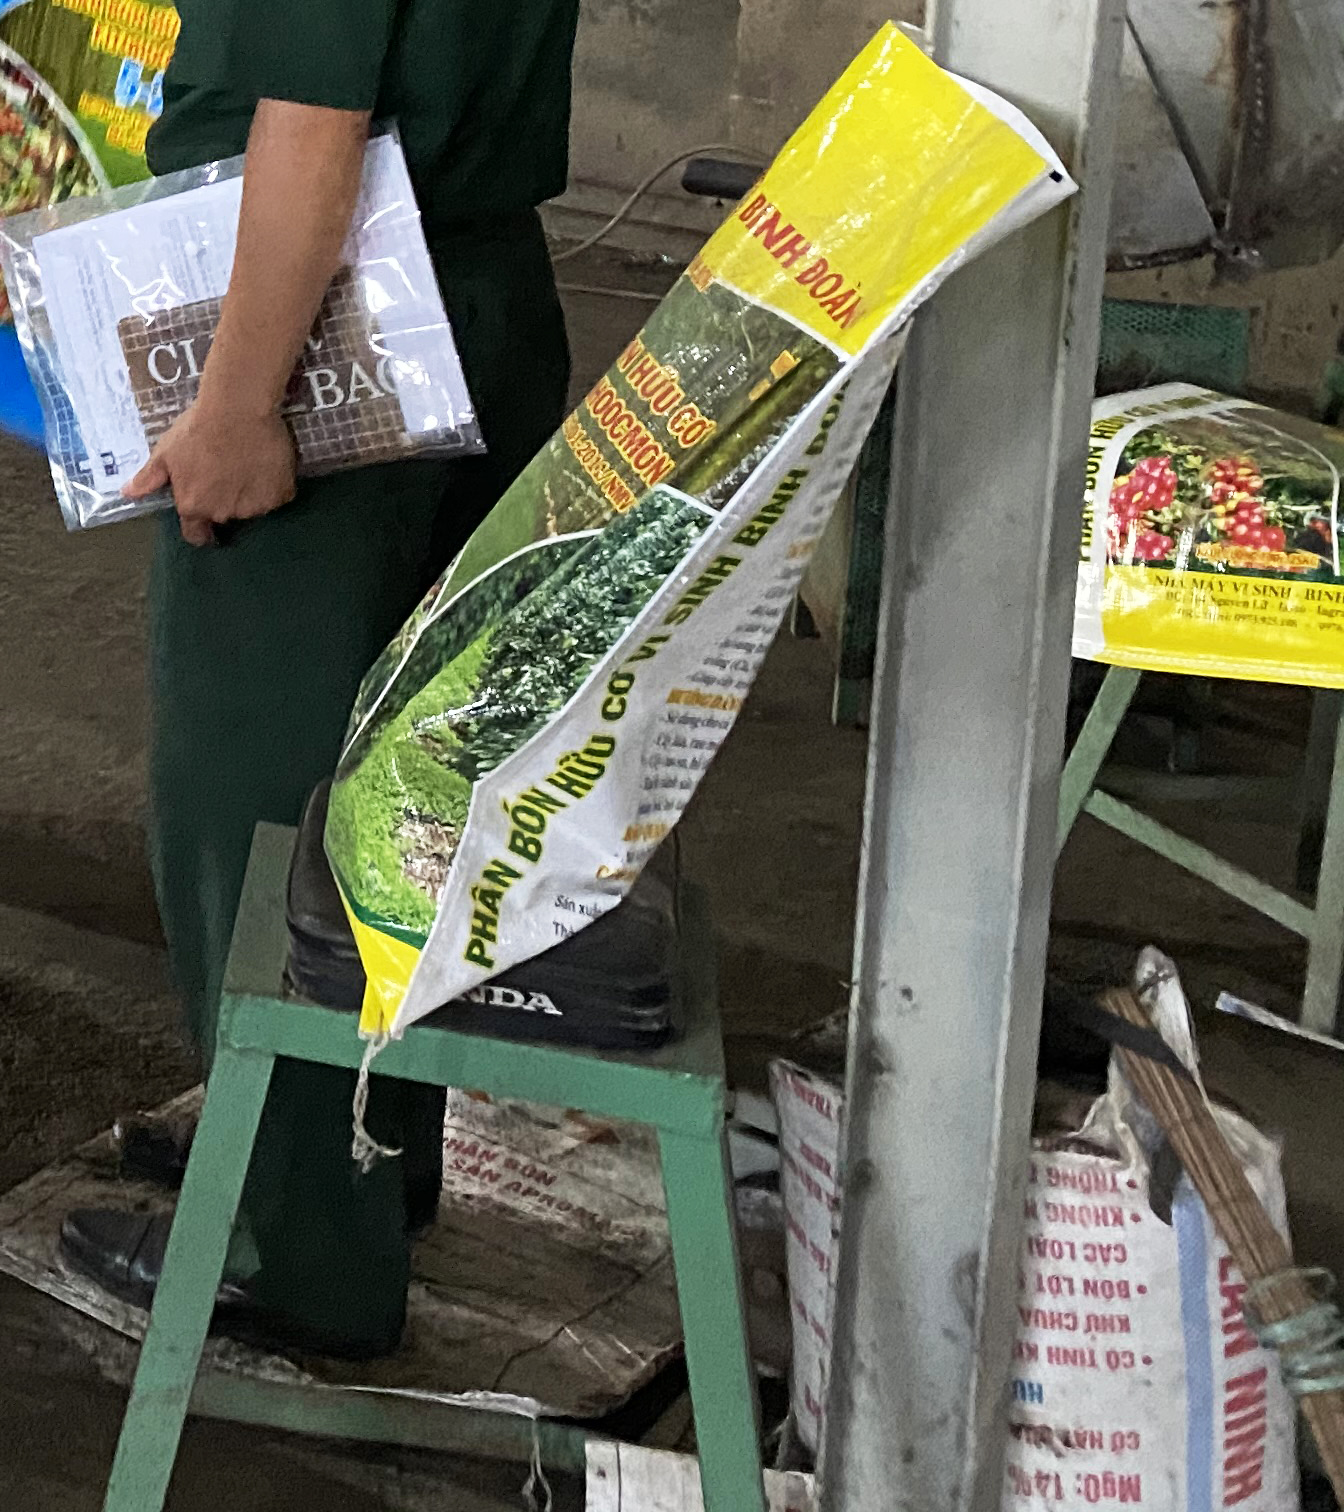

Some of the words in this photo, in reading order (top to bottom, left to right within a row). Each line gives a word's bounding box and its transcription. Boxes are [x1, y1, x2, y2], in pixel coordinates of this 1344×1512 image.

[667, 402, 718, 449] CƠ
[464, 859, 524, 969] PHÂN
[501, 785, 569, 864] BÓN
[545, 733, 616, 799] HỮU
[600, 670, 636, 722] CƠ
[626, 634, 672, 663] VI
[663, 555, 743, 626] SINH
[731, 468, 809, 546] BINH
